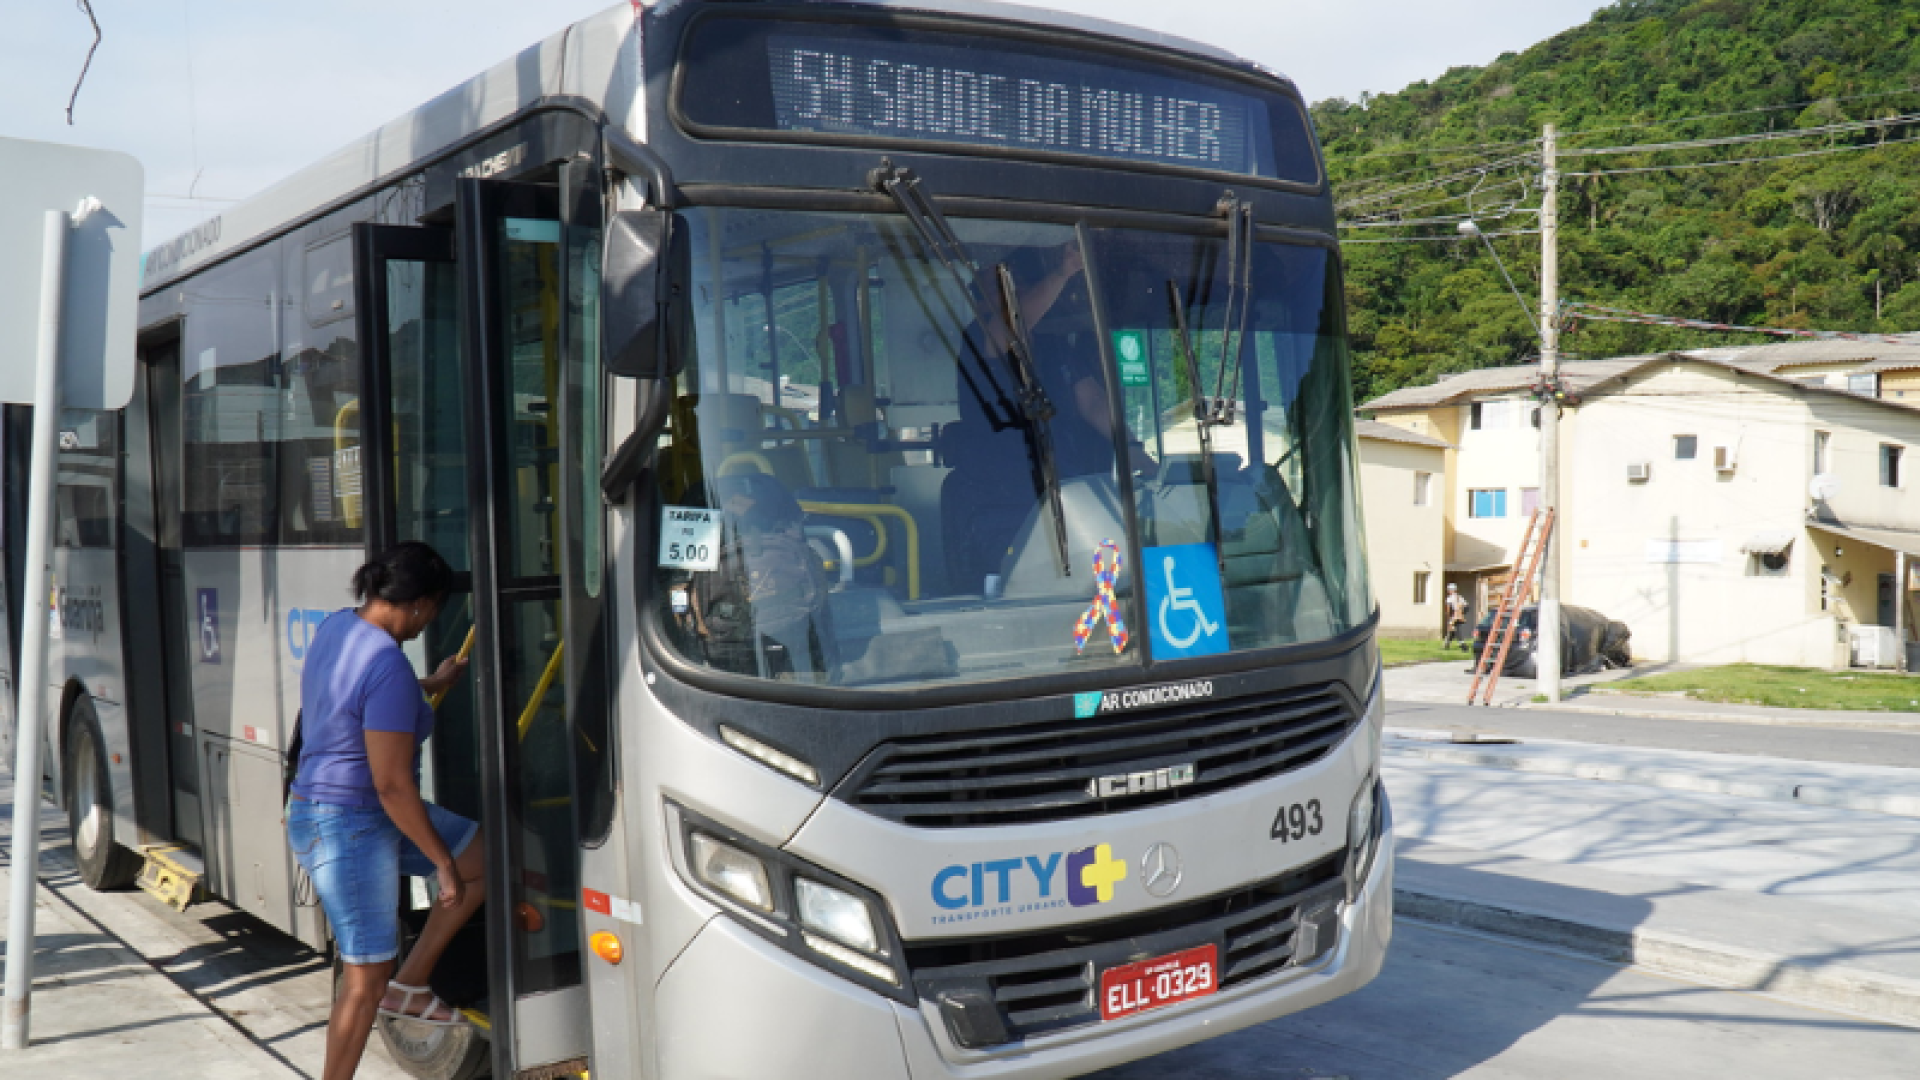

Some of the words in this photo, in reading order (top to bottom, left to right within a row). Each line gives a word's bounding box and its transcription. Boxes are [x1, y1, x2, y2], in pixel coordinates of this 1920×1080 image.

[793, 49, 853, 123] 54
[868, 59, 1006, 140] SAUDE
[1019, 78, 1069, 145] DA
[1081, 86, 1221, 162] MULHER
[669, 510, 711, 523] TARIFA
[1101, 693, 1120, 711] AR
[1122, 681, 1213, 709] CONDICIONADO
[1269, 798, 1324, 844] 493
[930, 905, 1014, 925] TRANSPORTE
